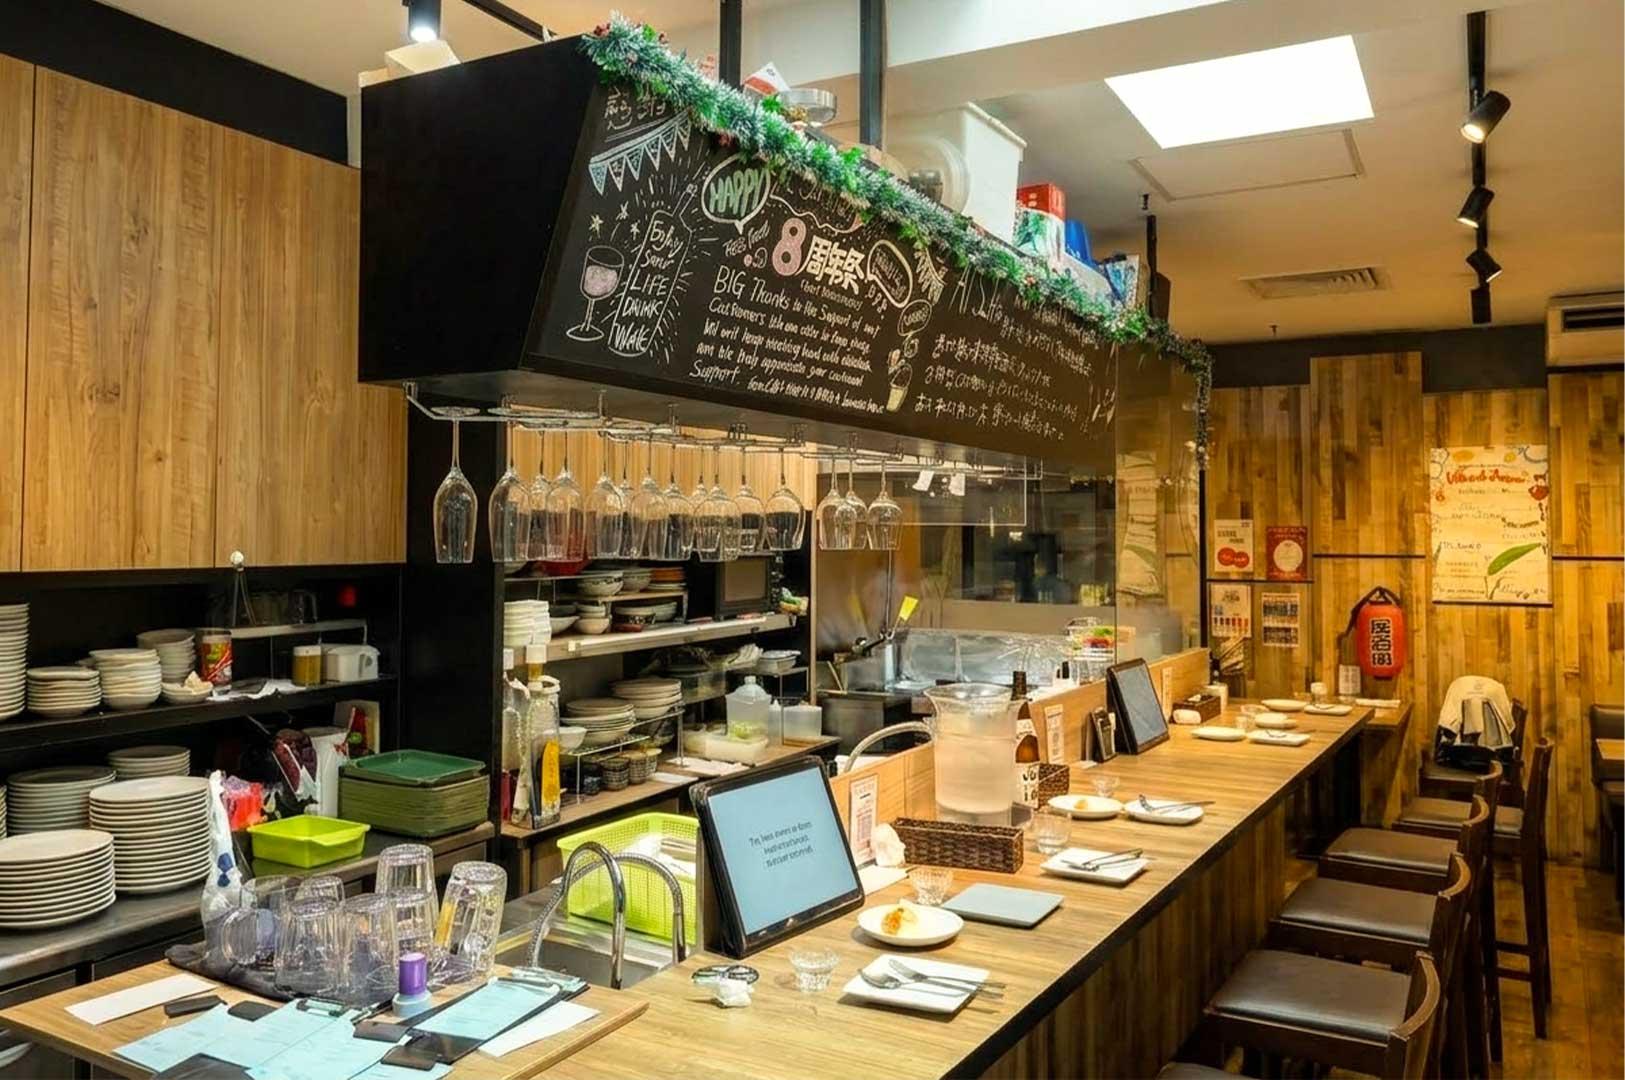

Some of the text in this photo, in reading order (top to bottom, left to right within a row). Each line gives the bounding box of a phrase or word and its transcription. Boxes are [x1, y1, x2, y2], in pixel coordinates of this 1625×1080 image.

[709, 166, 768, 218] HAPPY
[630, 269, 671, 297] LIFE
[714, 265, 747, 298] BIG
